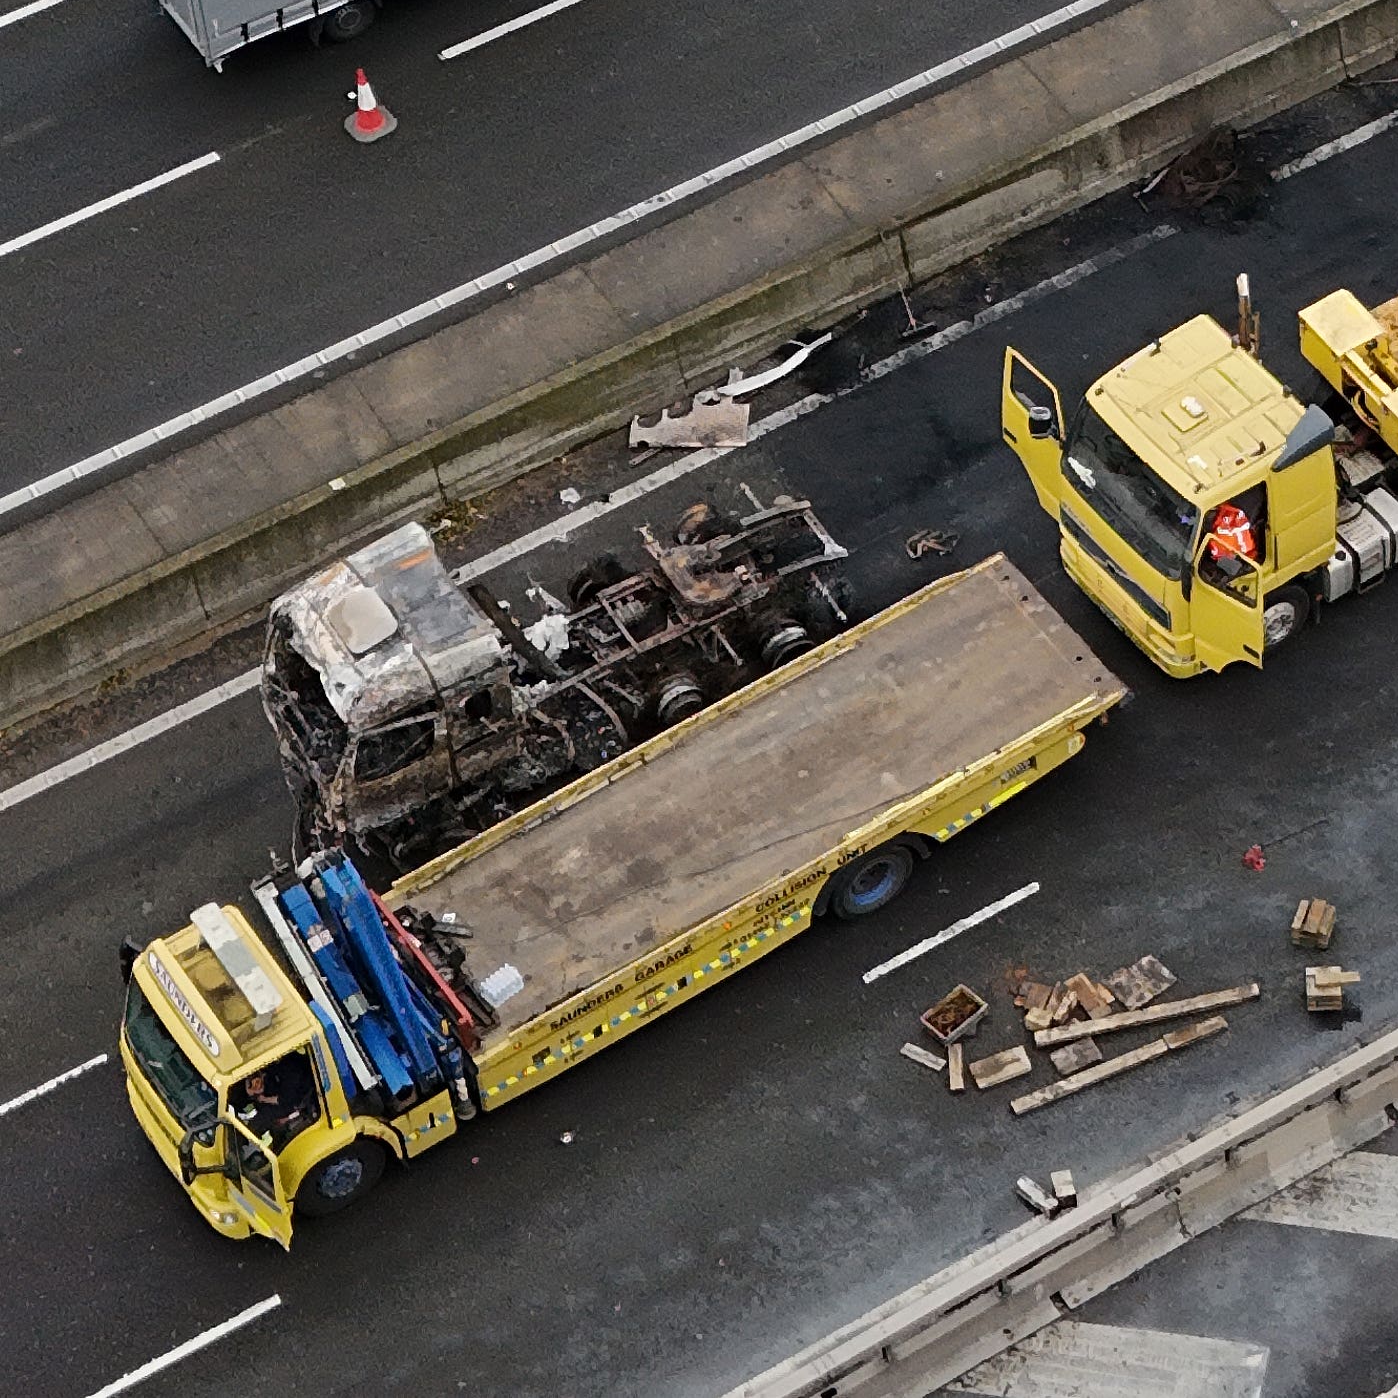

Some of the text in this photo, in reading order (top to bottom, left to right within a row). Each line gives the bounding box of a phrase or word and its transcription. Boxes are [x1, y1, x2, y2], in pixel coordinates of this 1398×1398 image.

[154, 959, 213, 1048] SAUNDERS
[549, 843, 868, 1031] SAUNDERS GARAGE COLLISION UNIT
